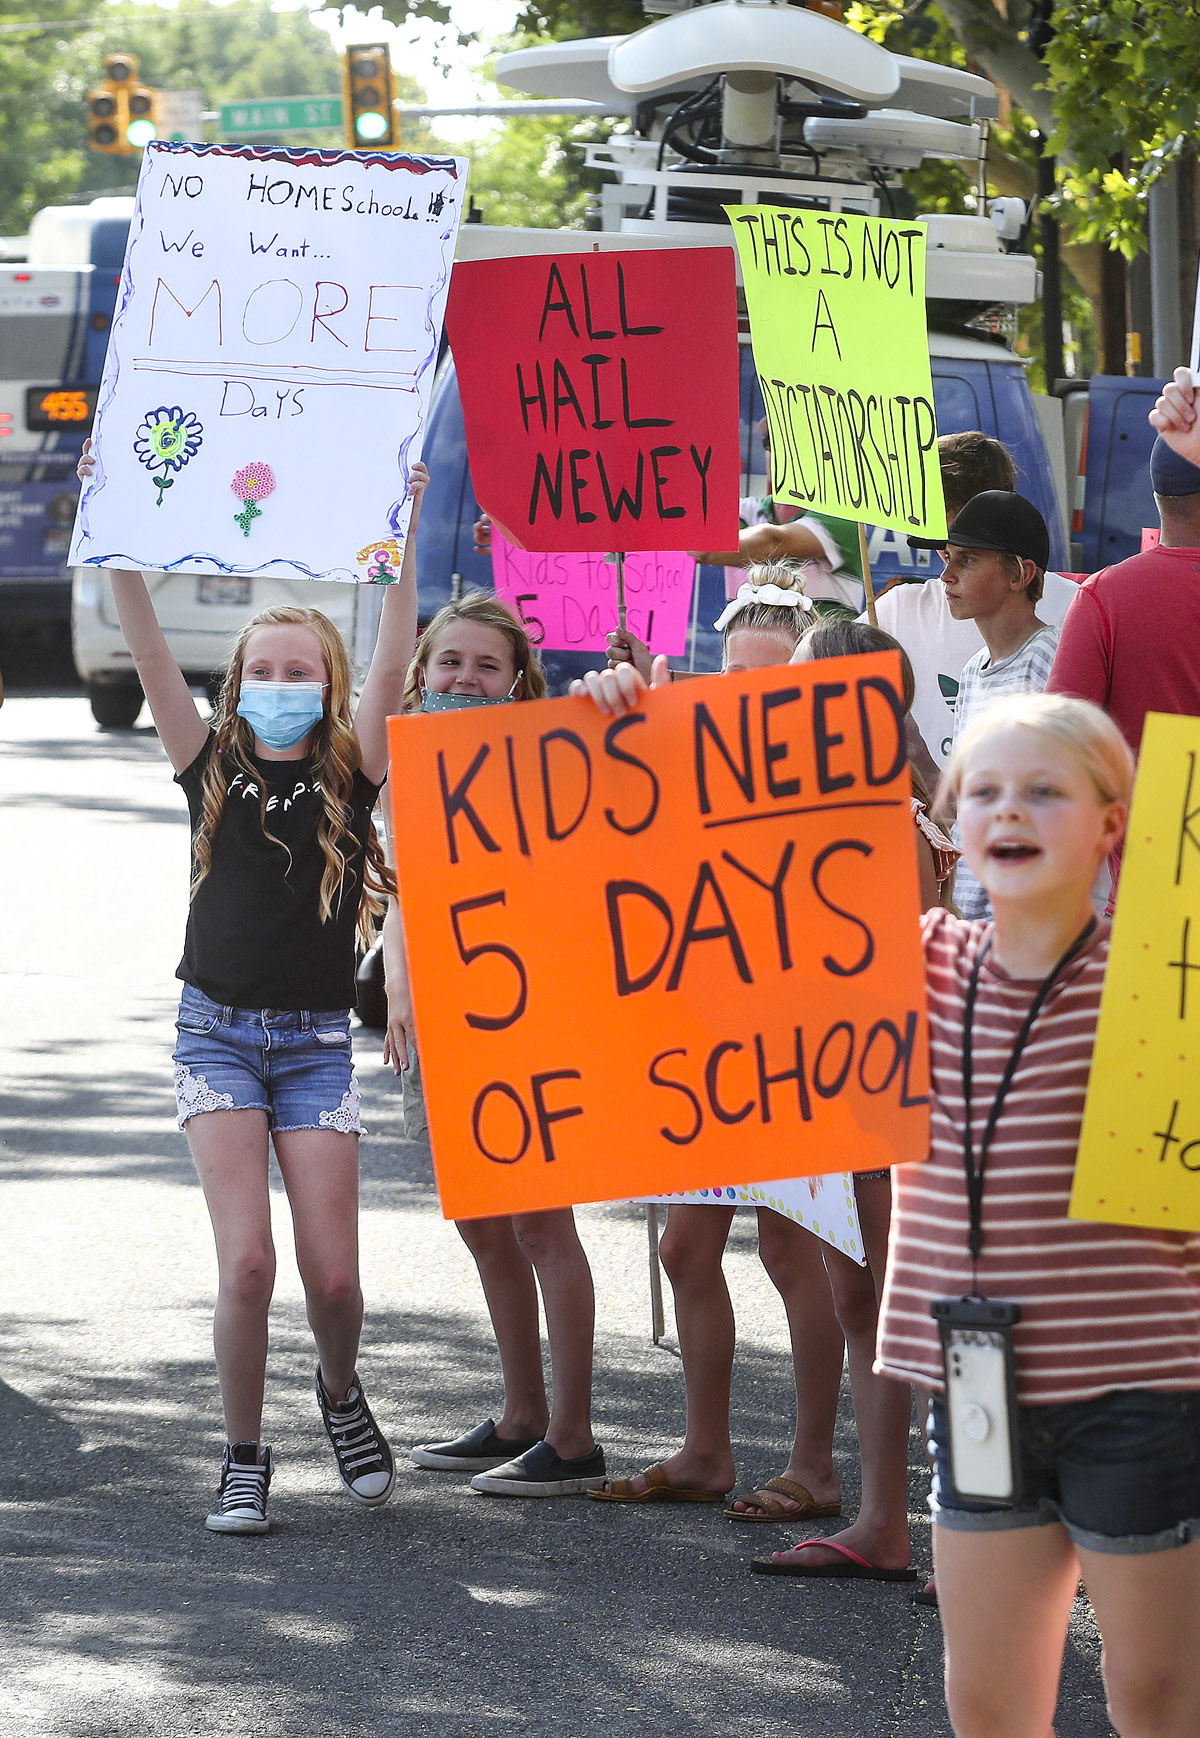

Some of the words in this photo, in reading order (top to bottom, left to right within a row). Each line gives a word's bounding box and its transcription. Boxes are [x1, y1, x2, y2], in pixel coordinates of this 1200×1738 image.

[231, 106, 290, 127] MAIN
[304, 103, 331, 123] ST
[160, 173, 203, 198] NO
[160, 229, 204, 258] We
[737, 213, 811, 277] THIS
[816, 218, 853, 280] IS
[863, 222, 924, 297] NOT
[148, 277, 424, 352] MORE
[538, 260, 664, 341] ALL
[811, 289, 842, 362] A
[516, 353, 676, 436] HAIL
[527, 443, 712, 526] NEWEY
[758, 373, 935, 527] DICTATORSHIP
[515, 594, 545, 644] 5
[436, 714, 660, 865] KIDS
[694, 676, 908, 814] NEED
[449, 890, 529, 1031] 5
[605, 839, 876, 998] DAYS
[472, 1068, 583, 1164] OF
[649, 1011, 931, 1146] SCHOOL
